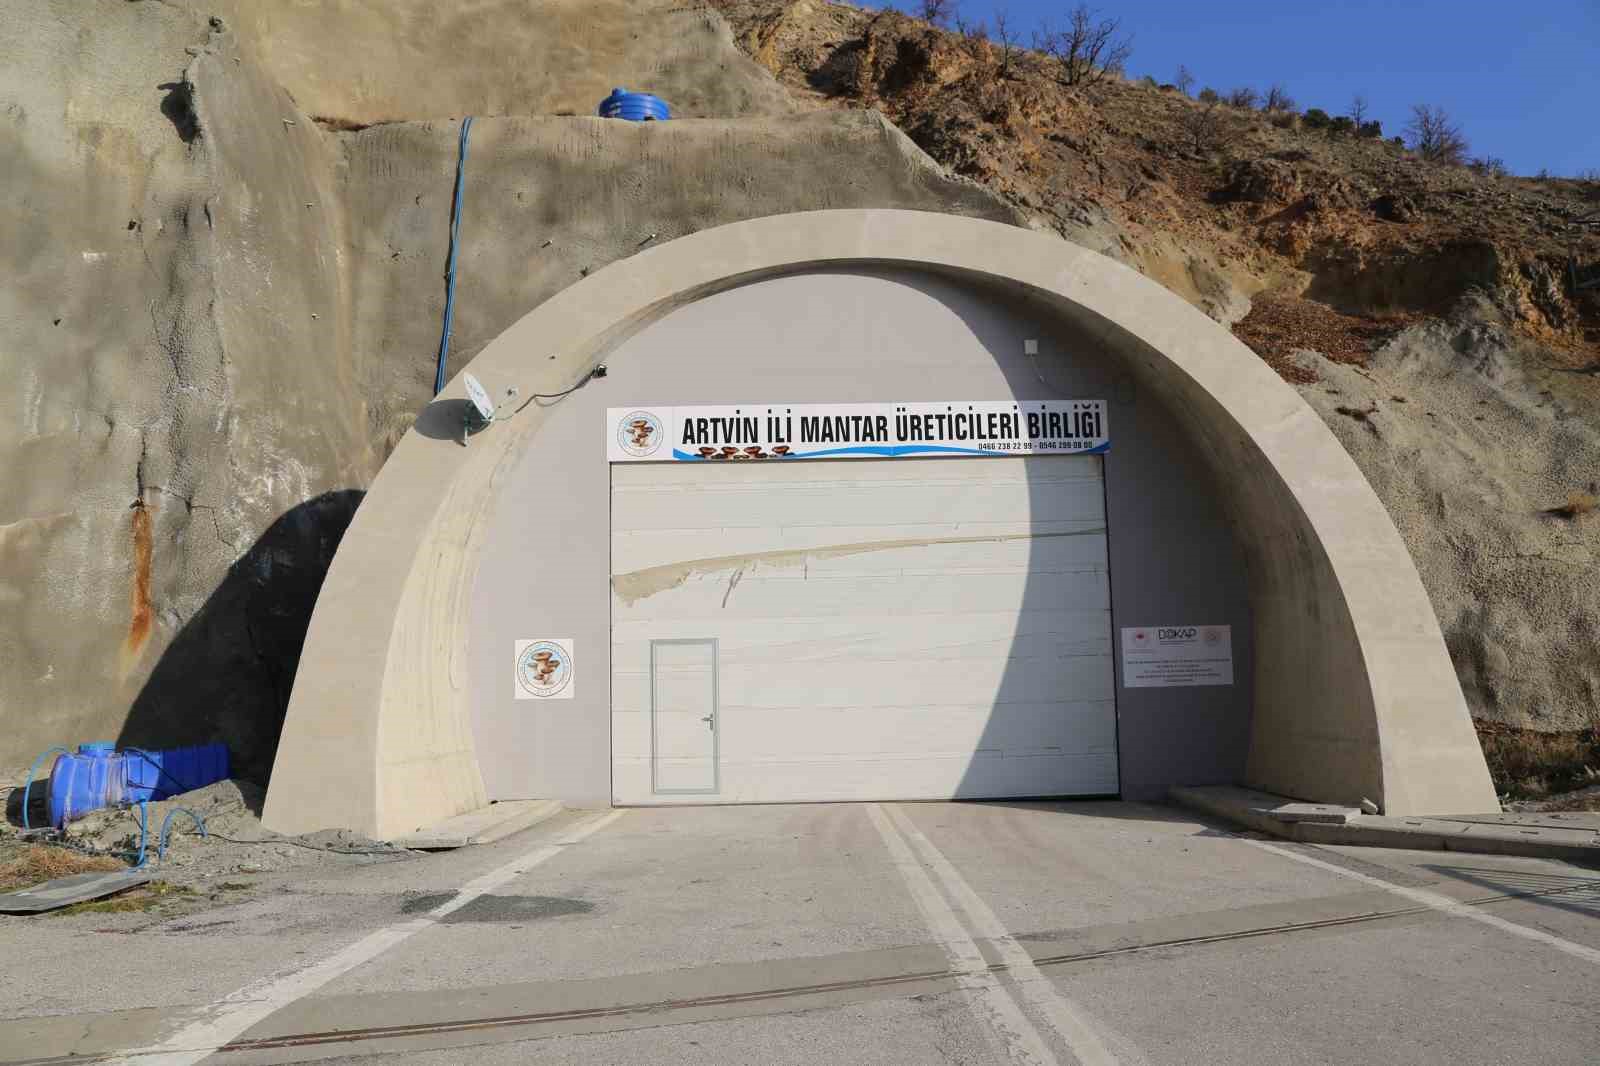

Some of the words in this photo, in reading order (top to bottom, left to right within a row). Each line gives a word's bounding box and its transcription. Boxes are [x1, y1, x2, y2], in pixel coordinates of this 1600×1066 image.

[682, 409, 758, 444] ARTVİN
[767, 408, 792, 443] İLİ
[800, 415, 888, 443] MANTAR
[896, 405, 1020, 441] ÜRETİCİLERİ
[1028, 403, 1101, 440] BİRLİĞİ
[1013, 442, 1021, 450] 22
